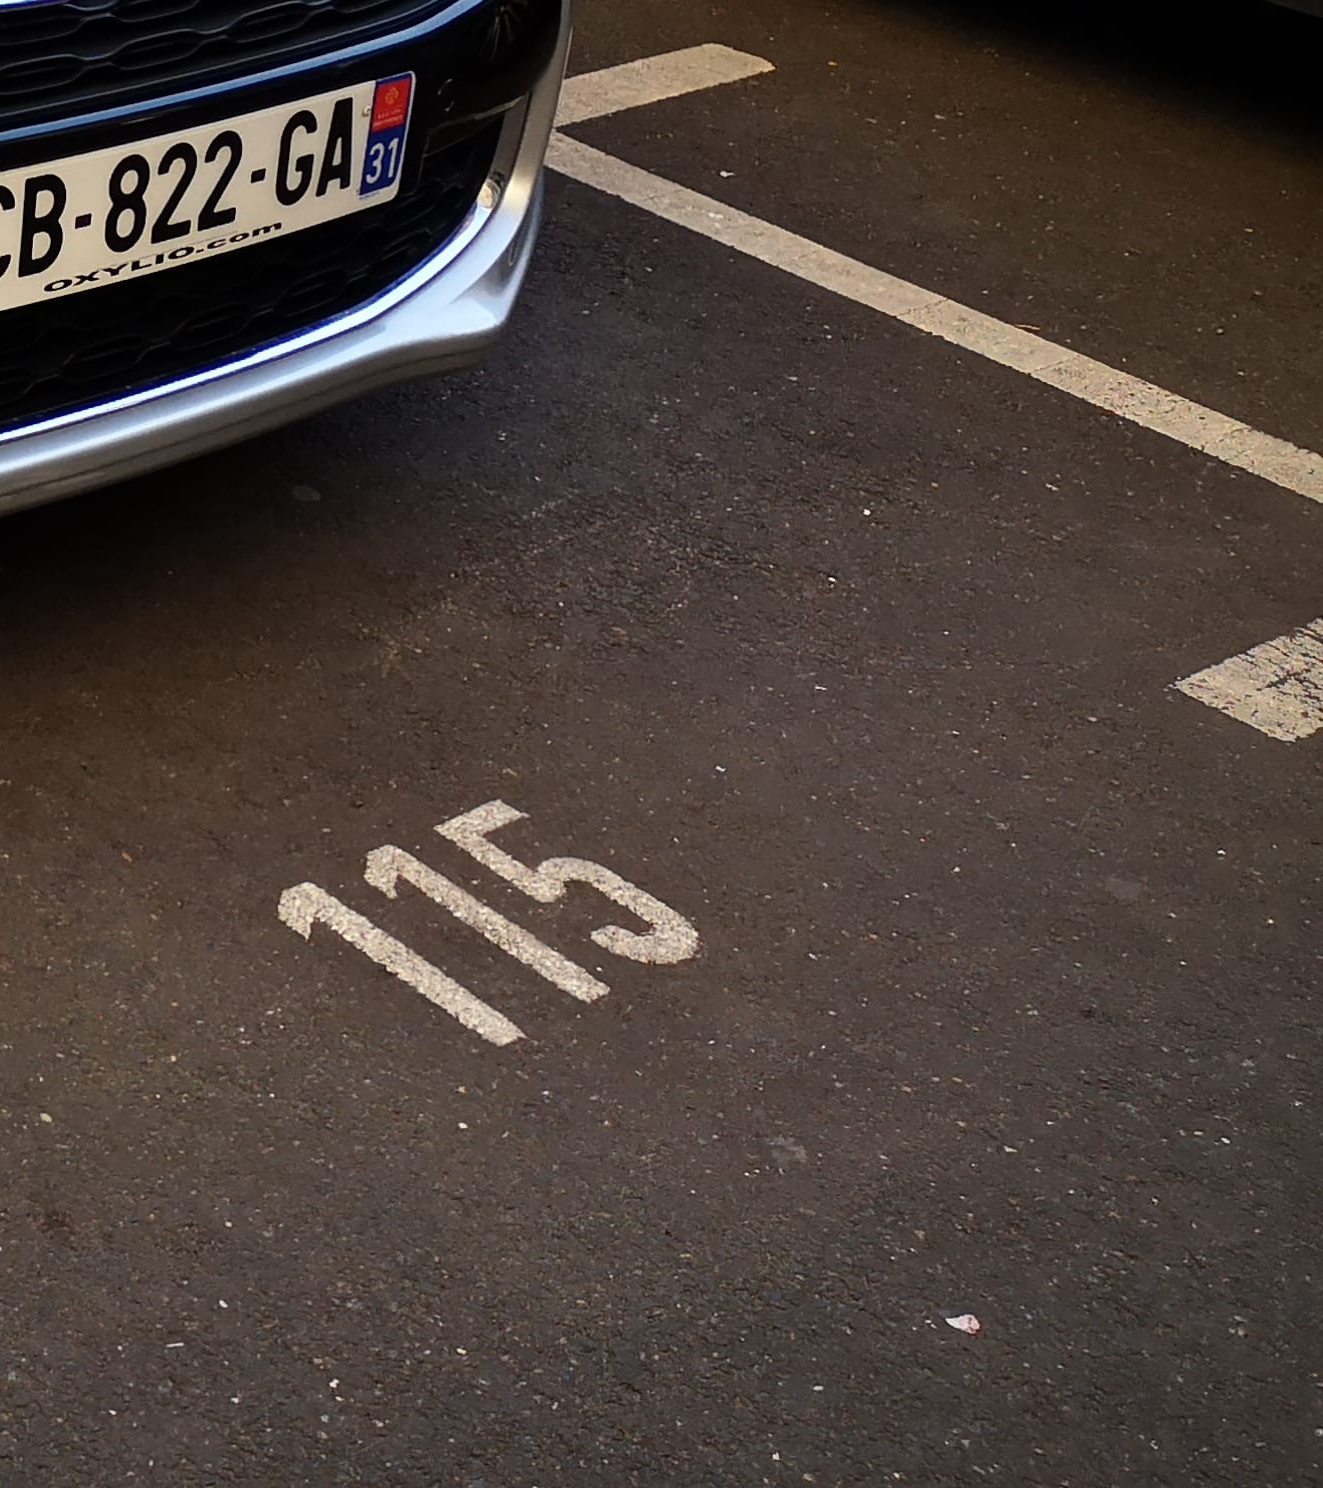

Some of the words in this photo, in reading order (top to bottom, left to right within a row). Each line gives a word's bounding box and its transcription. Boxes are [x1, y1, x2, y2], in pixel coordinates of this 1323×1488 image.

[366, 137, 399, 184] 31
[43, 222, 283, 292] OXYLIO.com
[278, 799, 700, 1047] 115
